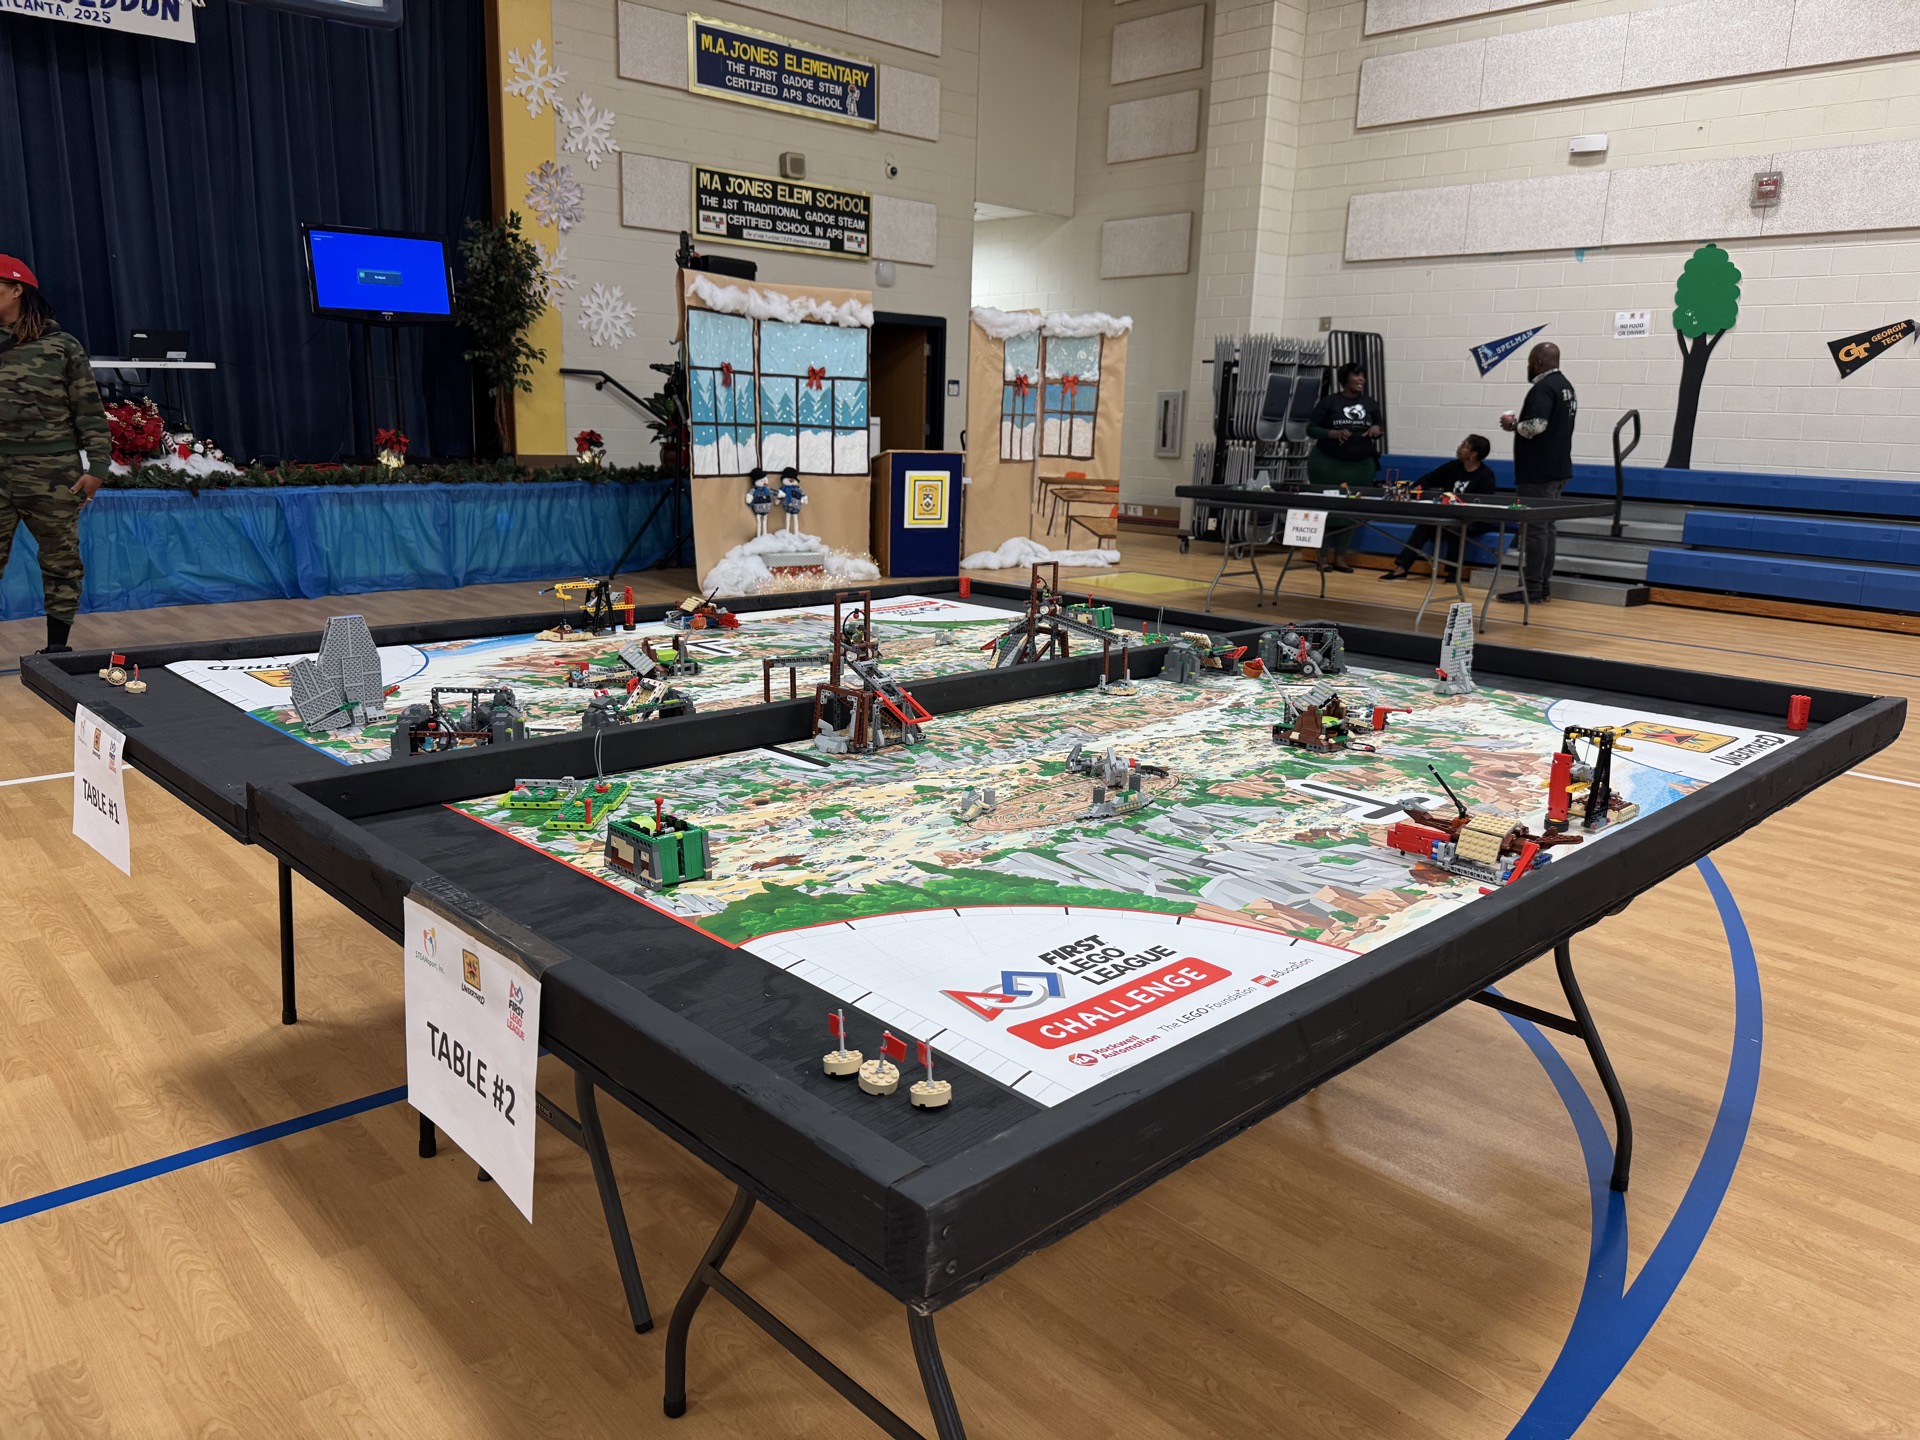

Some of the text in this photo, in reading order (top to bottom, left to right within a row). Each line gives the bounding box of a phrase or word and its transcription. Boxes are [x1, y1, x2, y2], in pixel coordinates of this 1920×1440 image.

[0, 0, 111, 24] LANTA, 2025
[701, 33, 870, 88] M.A. JONES ELEMENTARY
[726, 60, 843, 96] THE FIRST GADOE STEM
[725, 75, 843, 110] CERTIFIED APS SCHOOL
[700, 172, 868, 215] MA JONES ELEM SCHOOL
[700, 194, 866, 230] THE 1ST TRADITIONAL GADOE STEAM
[727, 214, 772, 229] CERTIFIED
[776, 222, 812, 236] SCHOOL
[815, 226, 824, 238] IN
[826, 228, 843, 240] APS
[1496, 329, 1533, 354] SPELMAN
[1871, 322, 1907, 342] GEORGIA
[1881, 332, 1903, 346] TECH
[1839, 342, 1870, 362] GT
[1292, 526, 1318, 534] PRACTICE
[1710, 734, 1786, 766] UNEARTHED
[82, 777, 120, 825] TABLE #1
[1038, 934, 1106, 966] FIRST
[1057, 947, 1126, 976] LEGO
[1081, 945, 1177, 986] LEAGUE
[1271, 958, 1314, 979] education
[508, 999, 525, 1019] FIRST
[1039, 965, 1208, 1040] CHALLENGE
[1157, 986, 1257, 1032] The LEGO Foundation
[506, 1018, 525, 1041] LEAGUE
[509, 1010, 523, 1028] LEGO
[1091, 1034, 1140, 1055] Rockwell
[1101, 1034, 1161, 1059] Automation
[426, 1021, 516, 1127] TABLE #2
